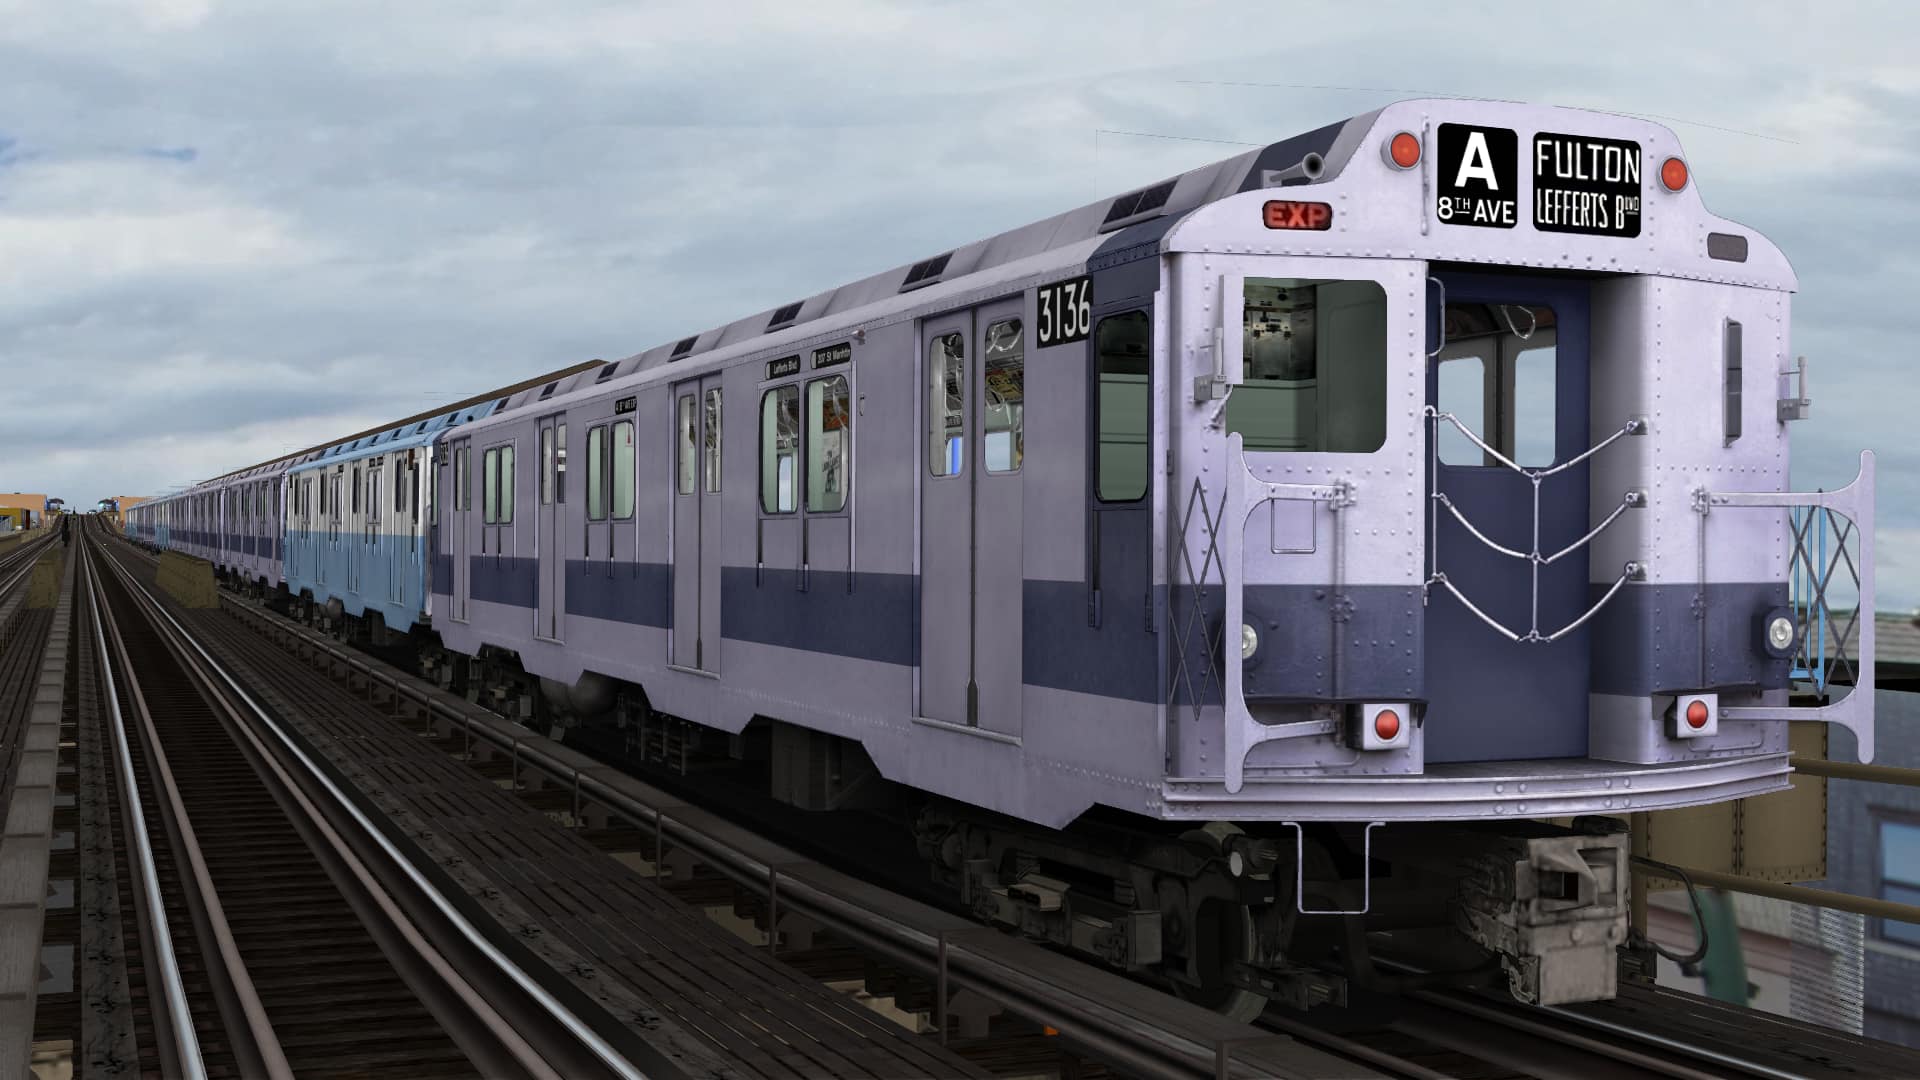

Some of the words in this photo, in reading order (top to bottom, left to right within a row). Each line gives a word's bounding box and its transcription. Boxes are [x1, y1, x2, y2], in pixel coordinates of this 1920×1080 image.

[1454, 131, 1499, 190] A
[1537, 140, 1639, 184] FULTON
[1267, 202, 1328, 227] EXP
[1473, 198, 1515, 224] AVE
[1537, 188, 1608, 228] LEFFERTS
[1040, 280, 1090, 342] 3136
